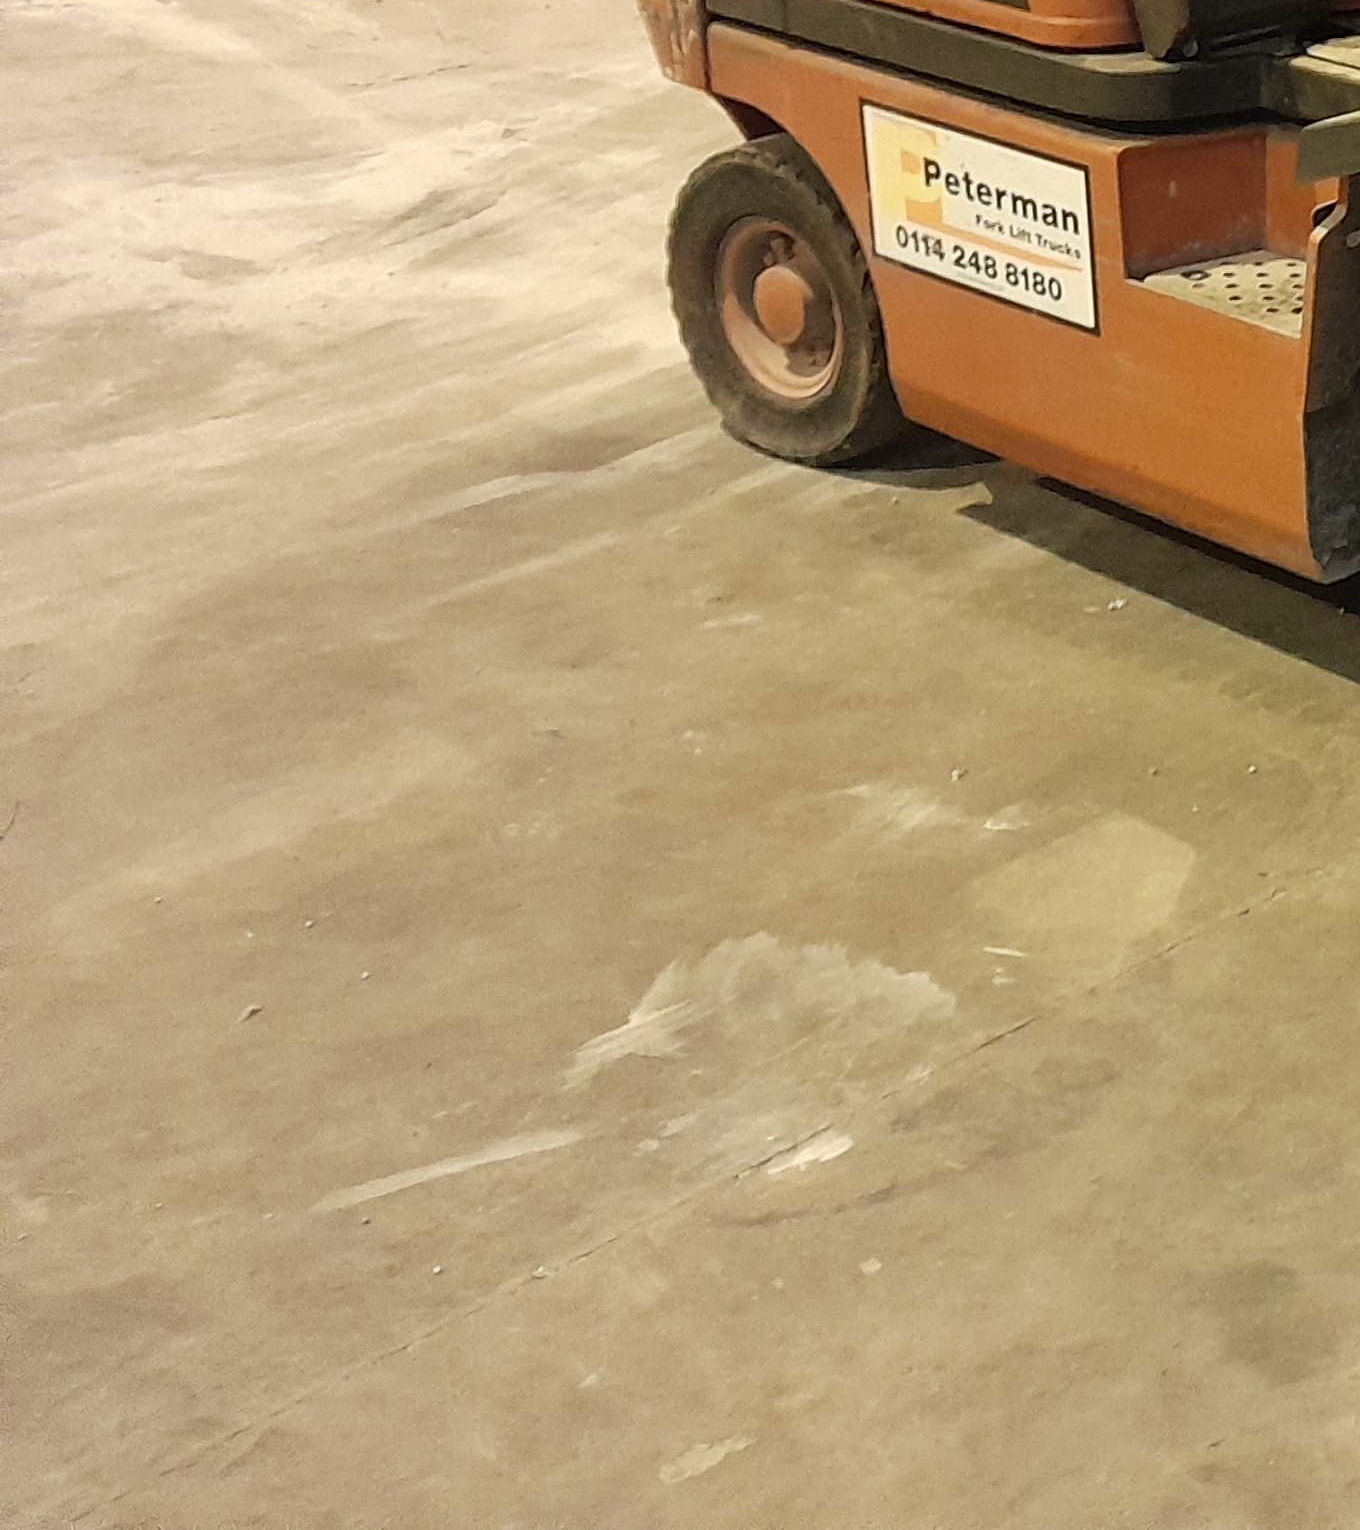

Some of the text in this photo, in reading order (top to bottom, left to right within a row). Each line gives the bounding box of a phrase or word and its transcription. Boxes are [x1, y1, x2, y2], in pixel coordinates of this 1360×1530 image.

[923, 156, 1081, 236] Peterman
[895, 223, 1063, 302] 0114 248 8180
[1009, 224, 1032, 244] Lift
[1035, 233, 1082, 260] Trucks
